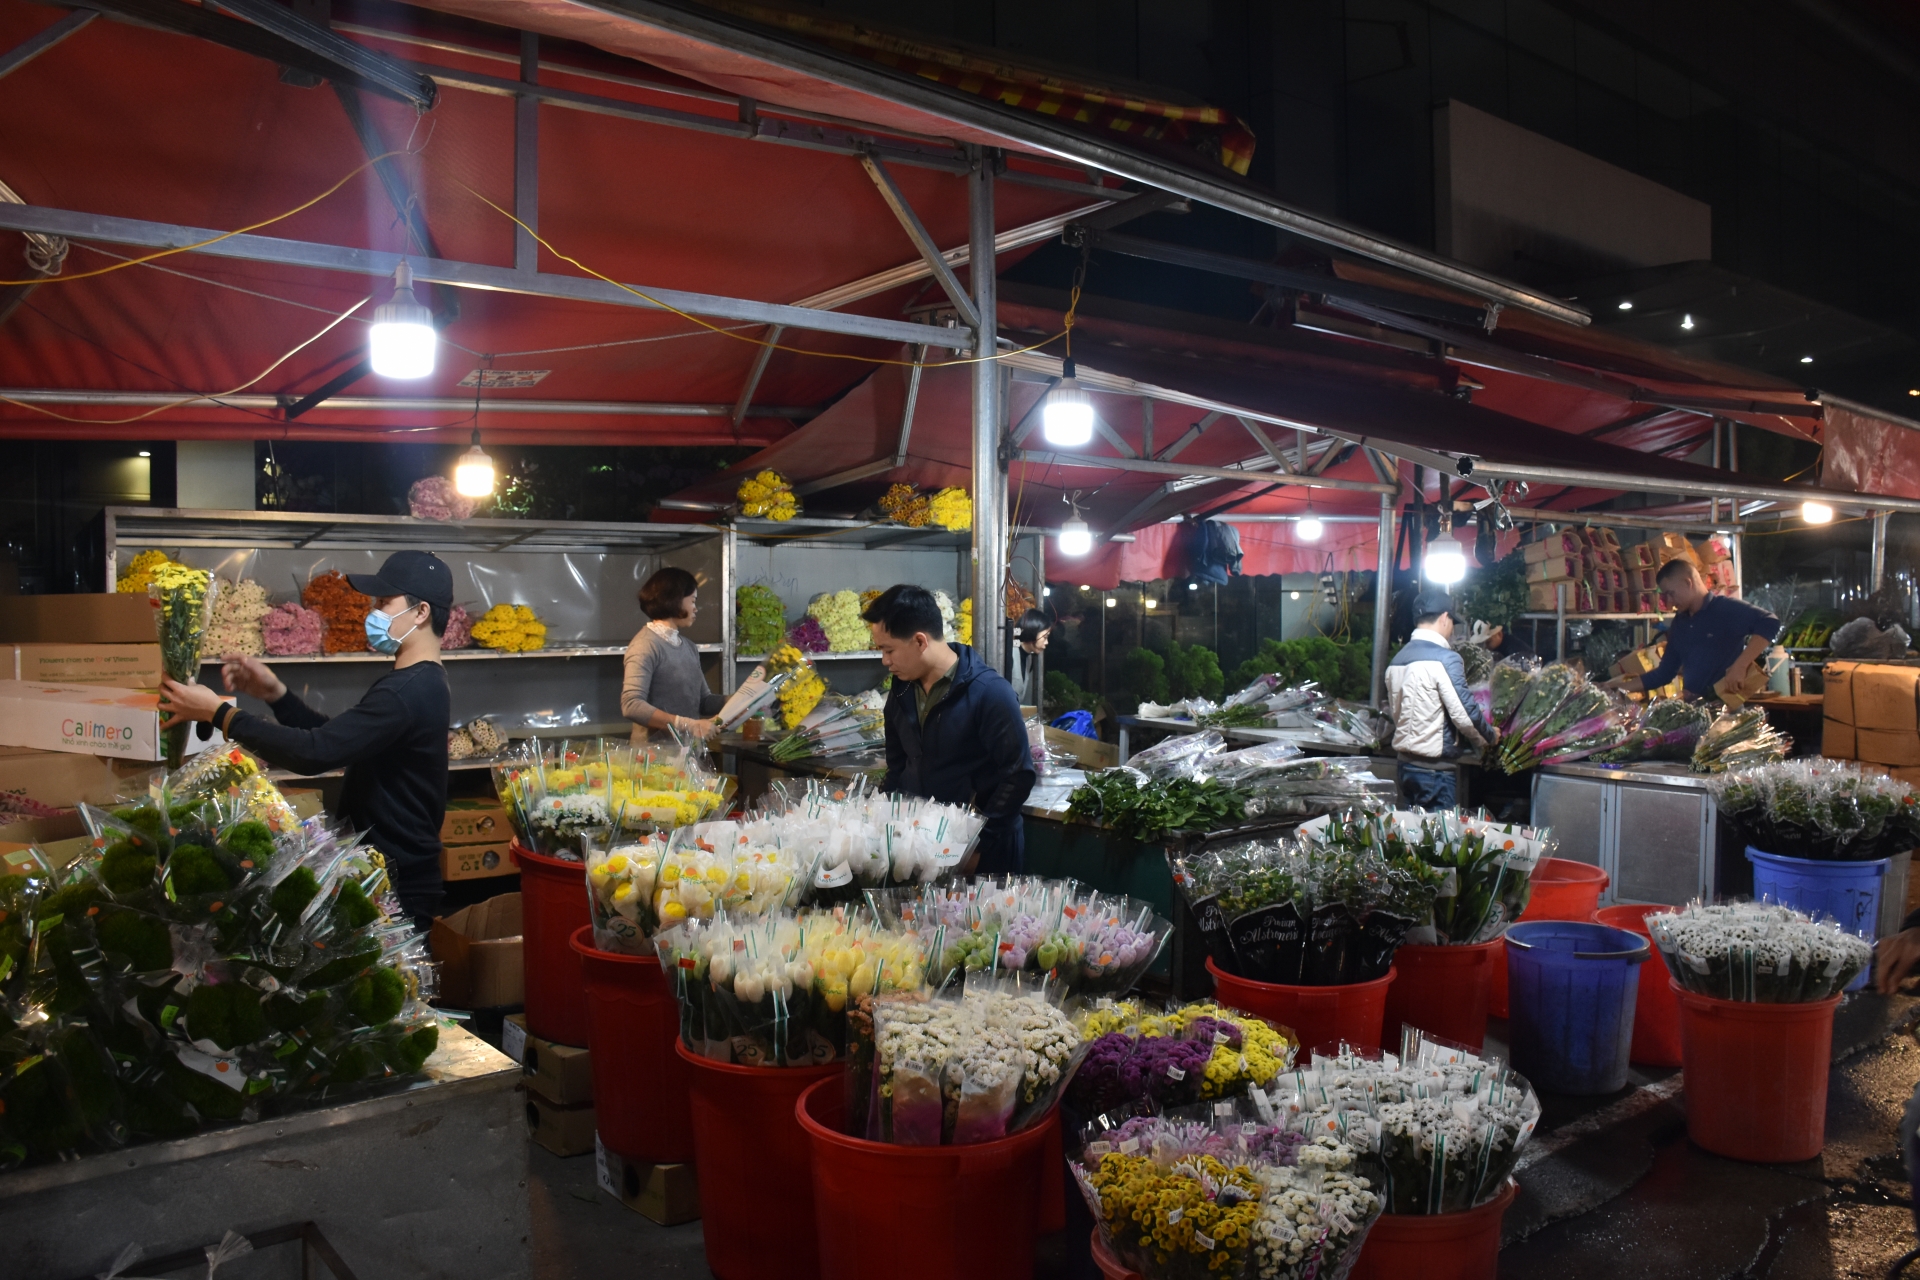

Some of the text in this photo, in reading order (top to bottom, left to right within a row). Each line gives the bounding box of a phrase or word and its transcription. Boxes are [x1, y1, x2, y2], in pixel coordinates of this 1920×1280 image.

[61, 718, 133, 740] Calimero
[629, 815, 672, 825] Hasfarm
[934, 851, 960, 861] Hasfarm
[1487, 843, 1534, 863] Hsfarm
[673, 867, 716, 886] Hasfarm
[817, 872, 848, 884] Hasfarm
[616, 923, 637, 938] 25
[736, 1044, 758, 1057] 25
